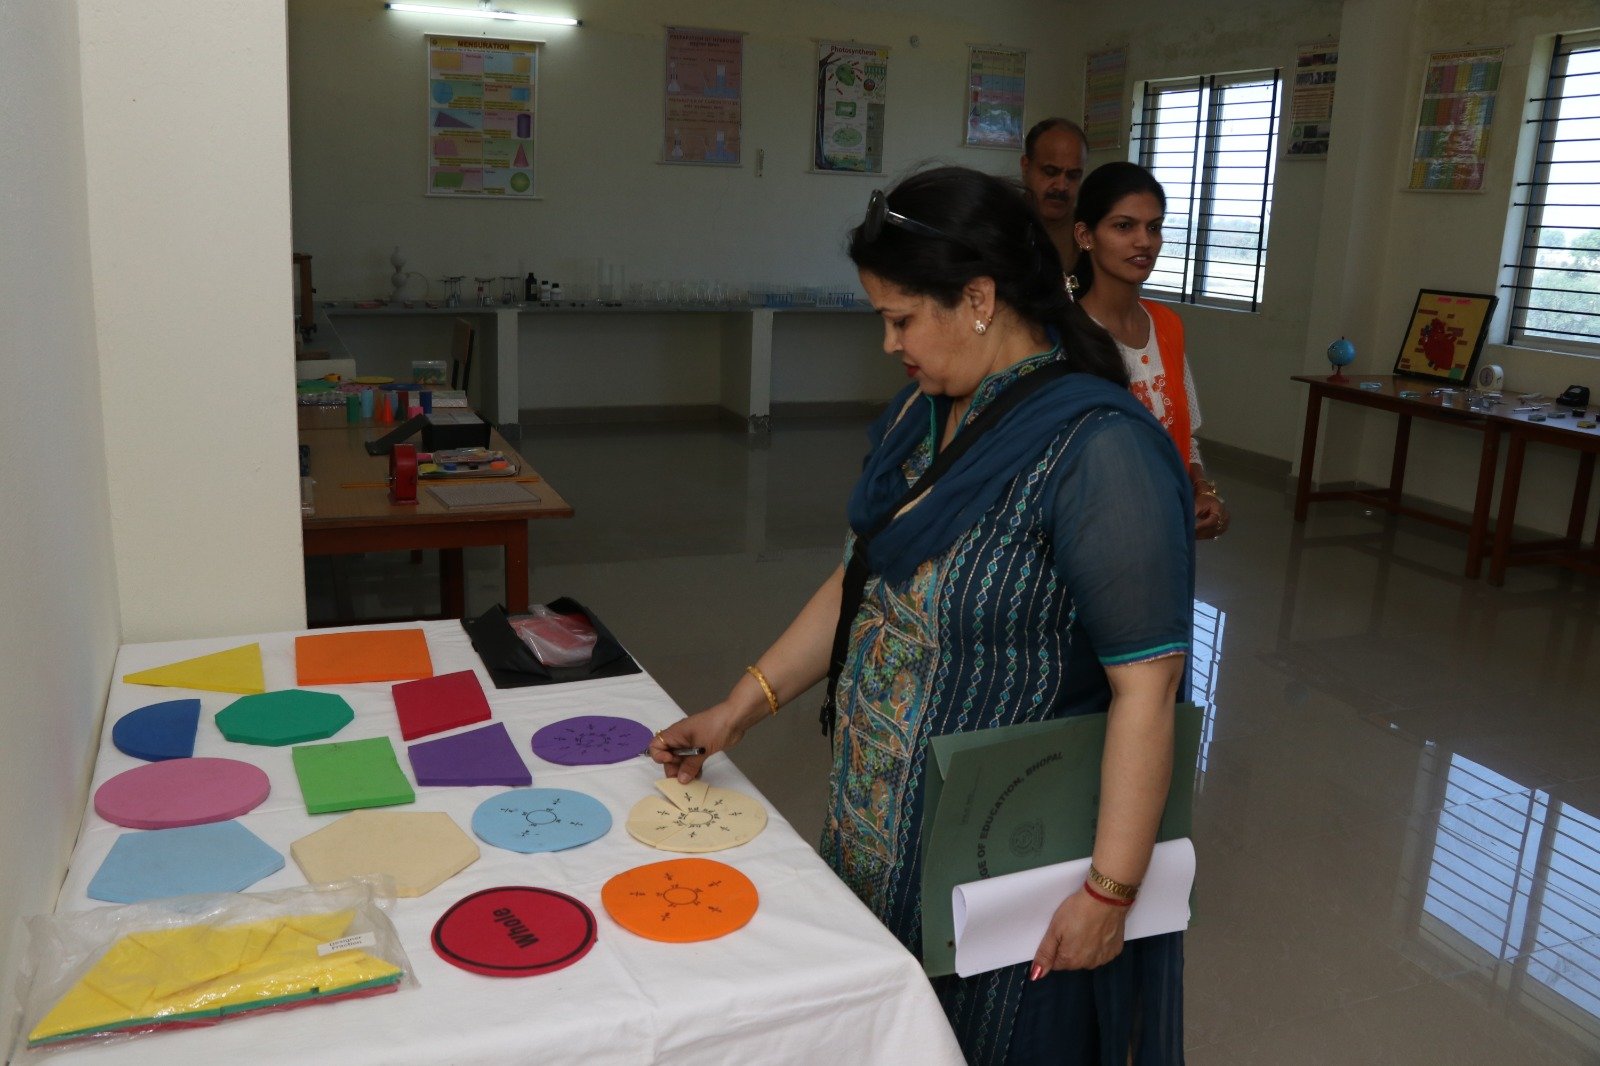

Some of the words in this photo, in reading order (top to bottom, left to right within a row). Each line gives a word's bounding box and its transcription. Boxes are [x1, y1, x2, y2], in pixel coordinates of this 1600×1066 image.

[977, 844, 987, 858] OF
[1026, 751, 1064, 776] BHOPAL
[492, 906, 540, 949] Whole
